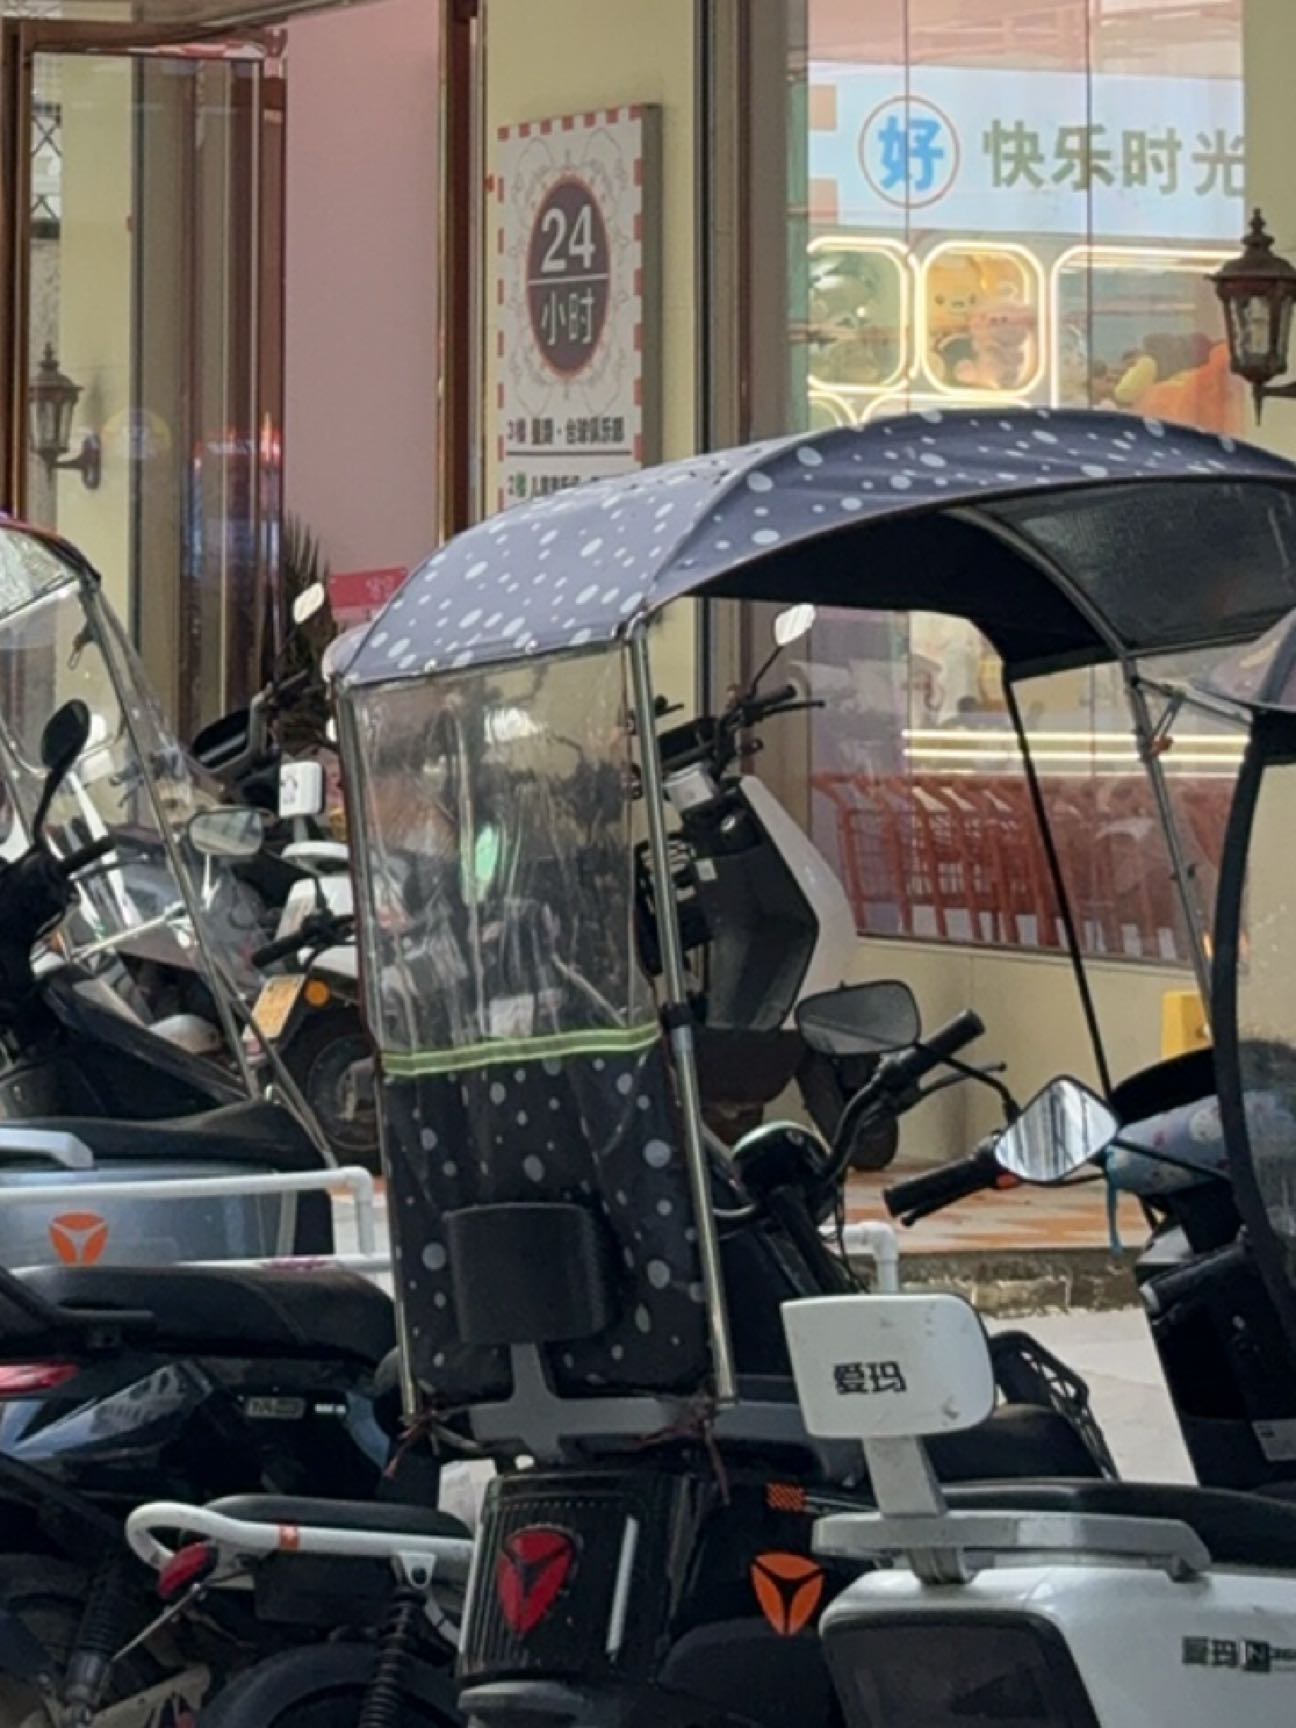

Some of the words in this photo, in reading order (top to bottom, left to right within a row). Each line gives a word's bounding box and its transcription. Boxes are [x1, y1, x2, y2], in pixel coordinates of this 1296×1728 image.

[877, 115, 944, 190] 好
[982, 119, 1244, 197] 快乐时光
[540, 205, 596, 273] 24
[540, 287, 595, 346] 小时
[834, 1360, 907, 1395] 爱玛
